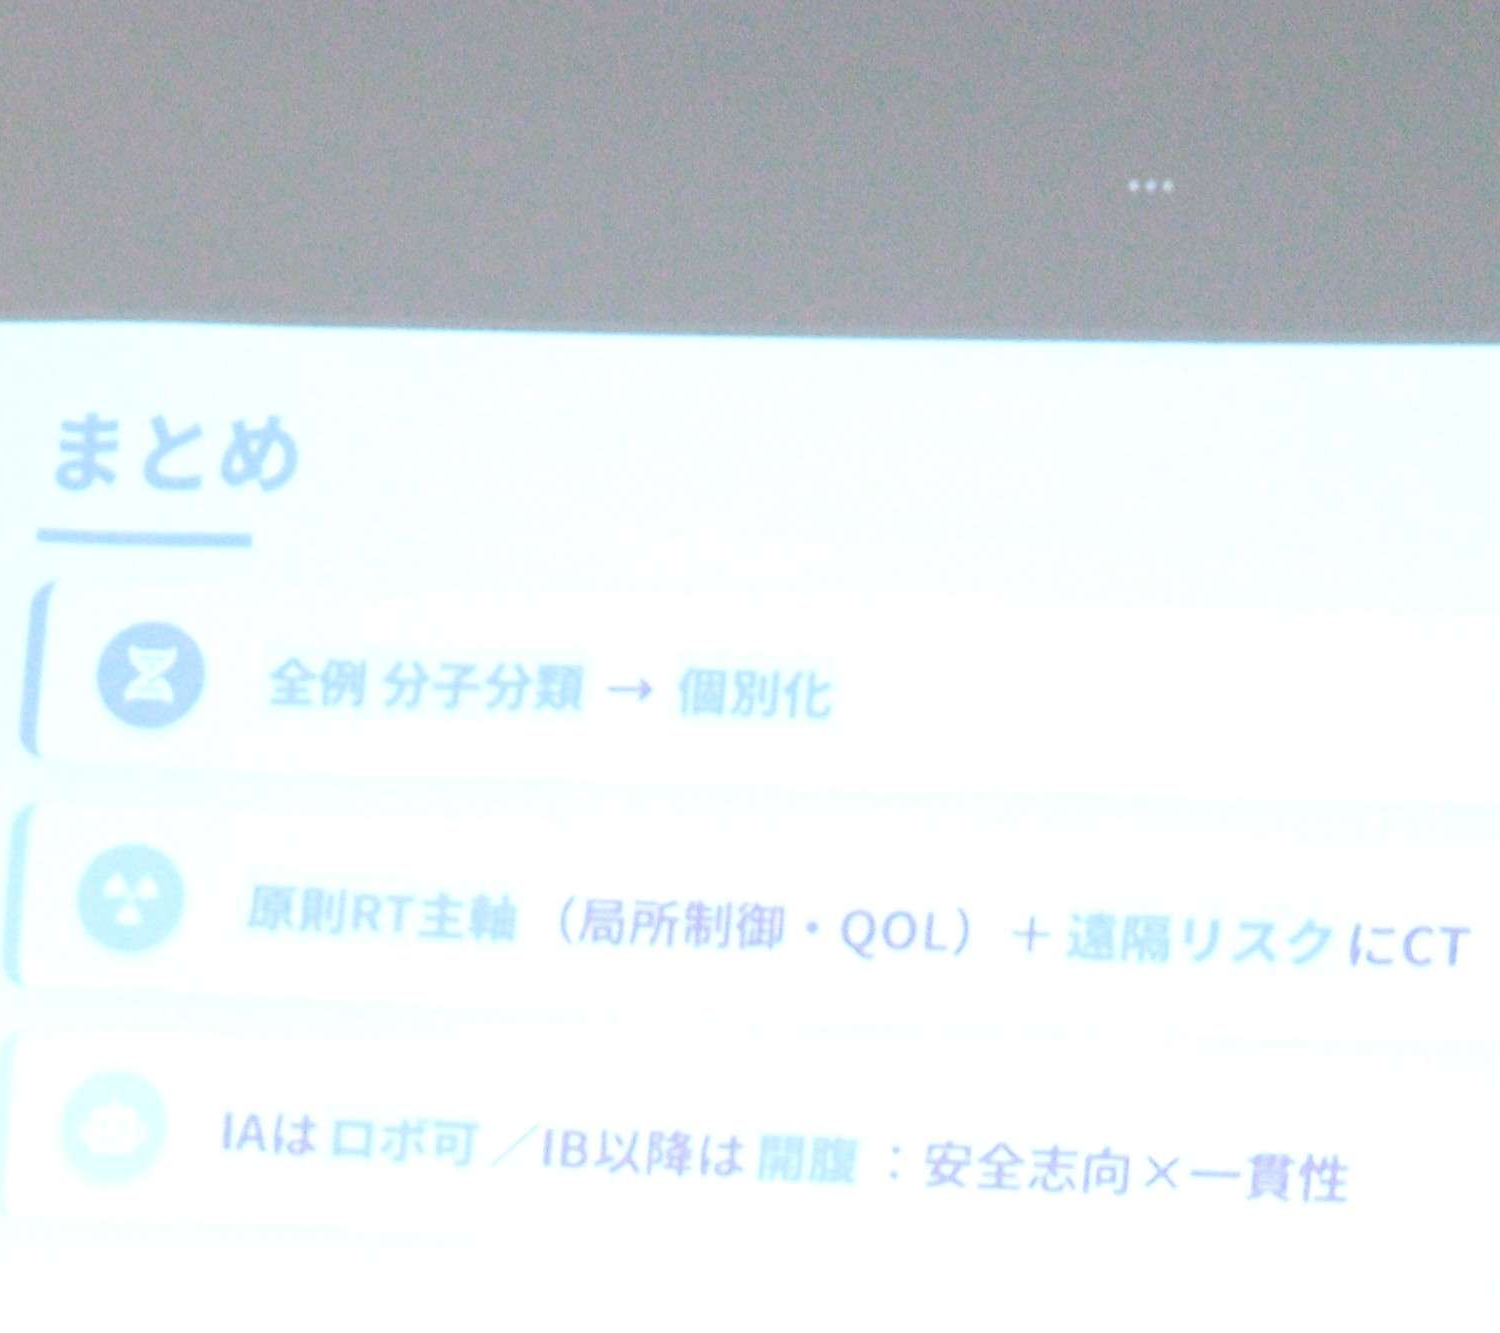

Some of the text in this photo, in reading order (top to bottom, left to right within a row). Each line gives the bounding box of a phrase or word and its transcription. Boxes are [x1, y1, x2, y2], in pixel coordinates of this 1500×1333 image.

[54, 411, 300, 494] まとめ
[268, 656, 835, 722] 全例 分子分類 個別化
